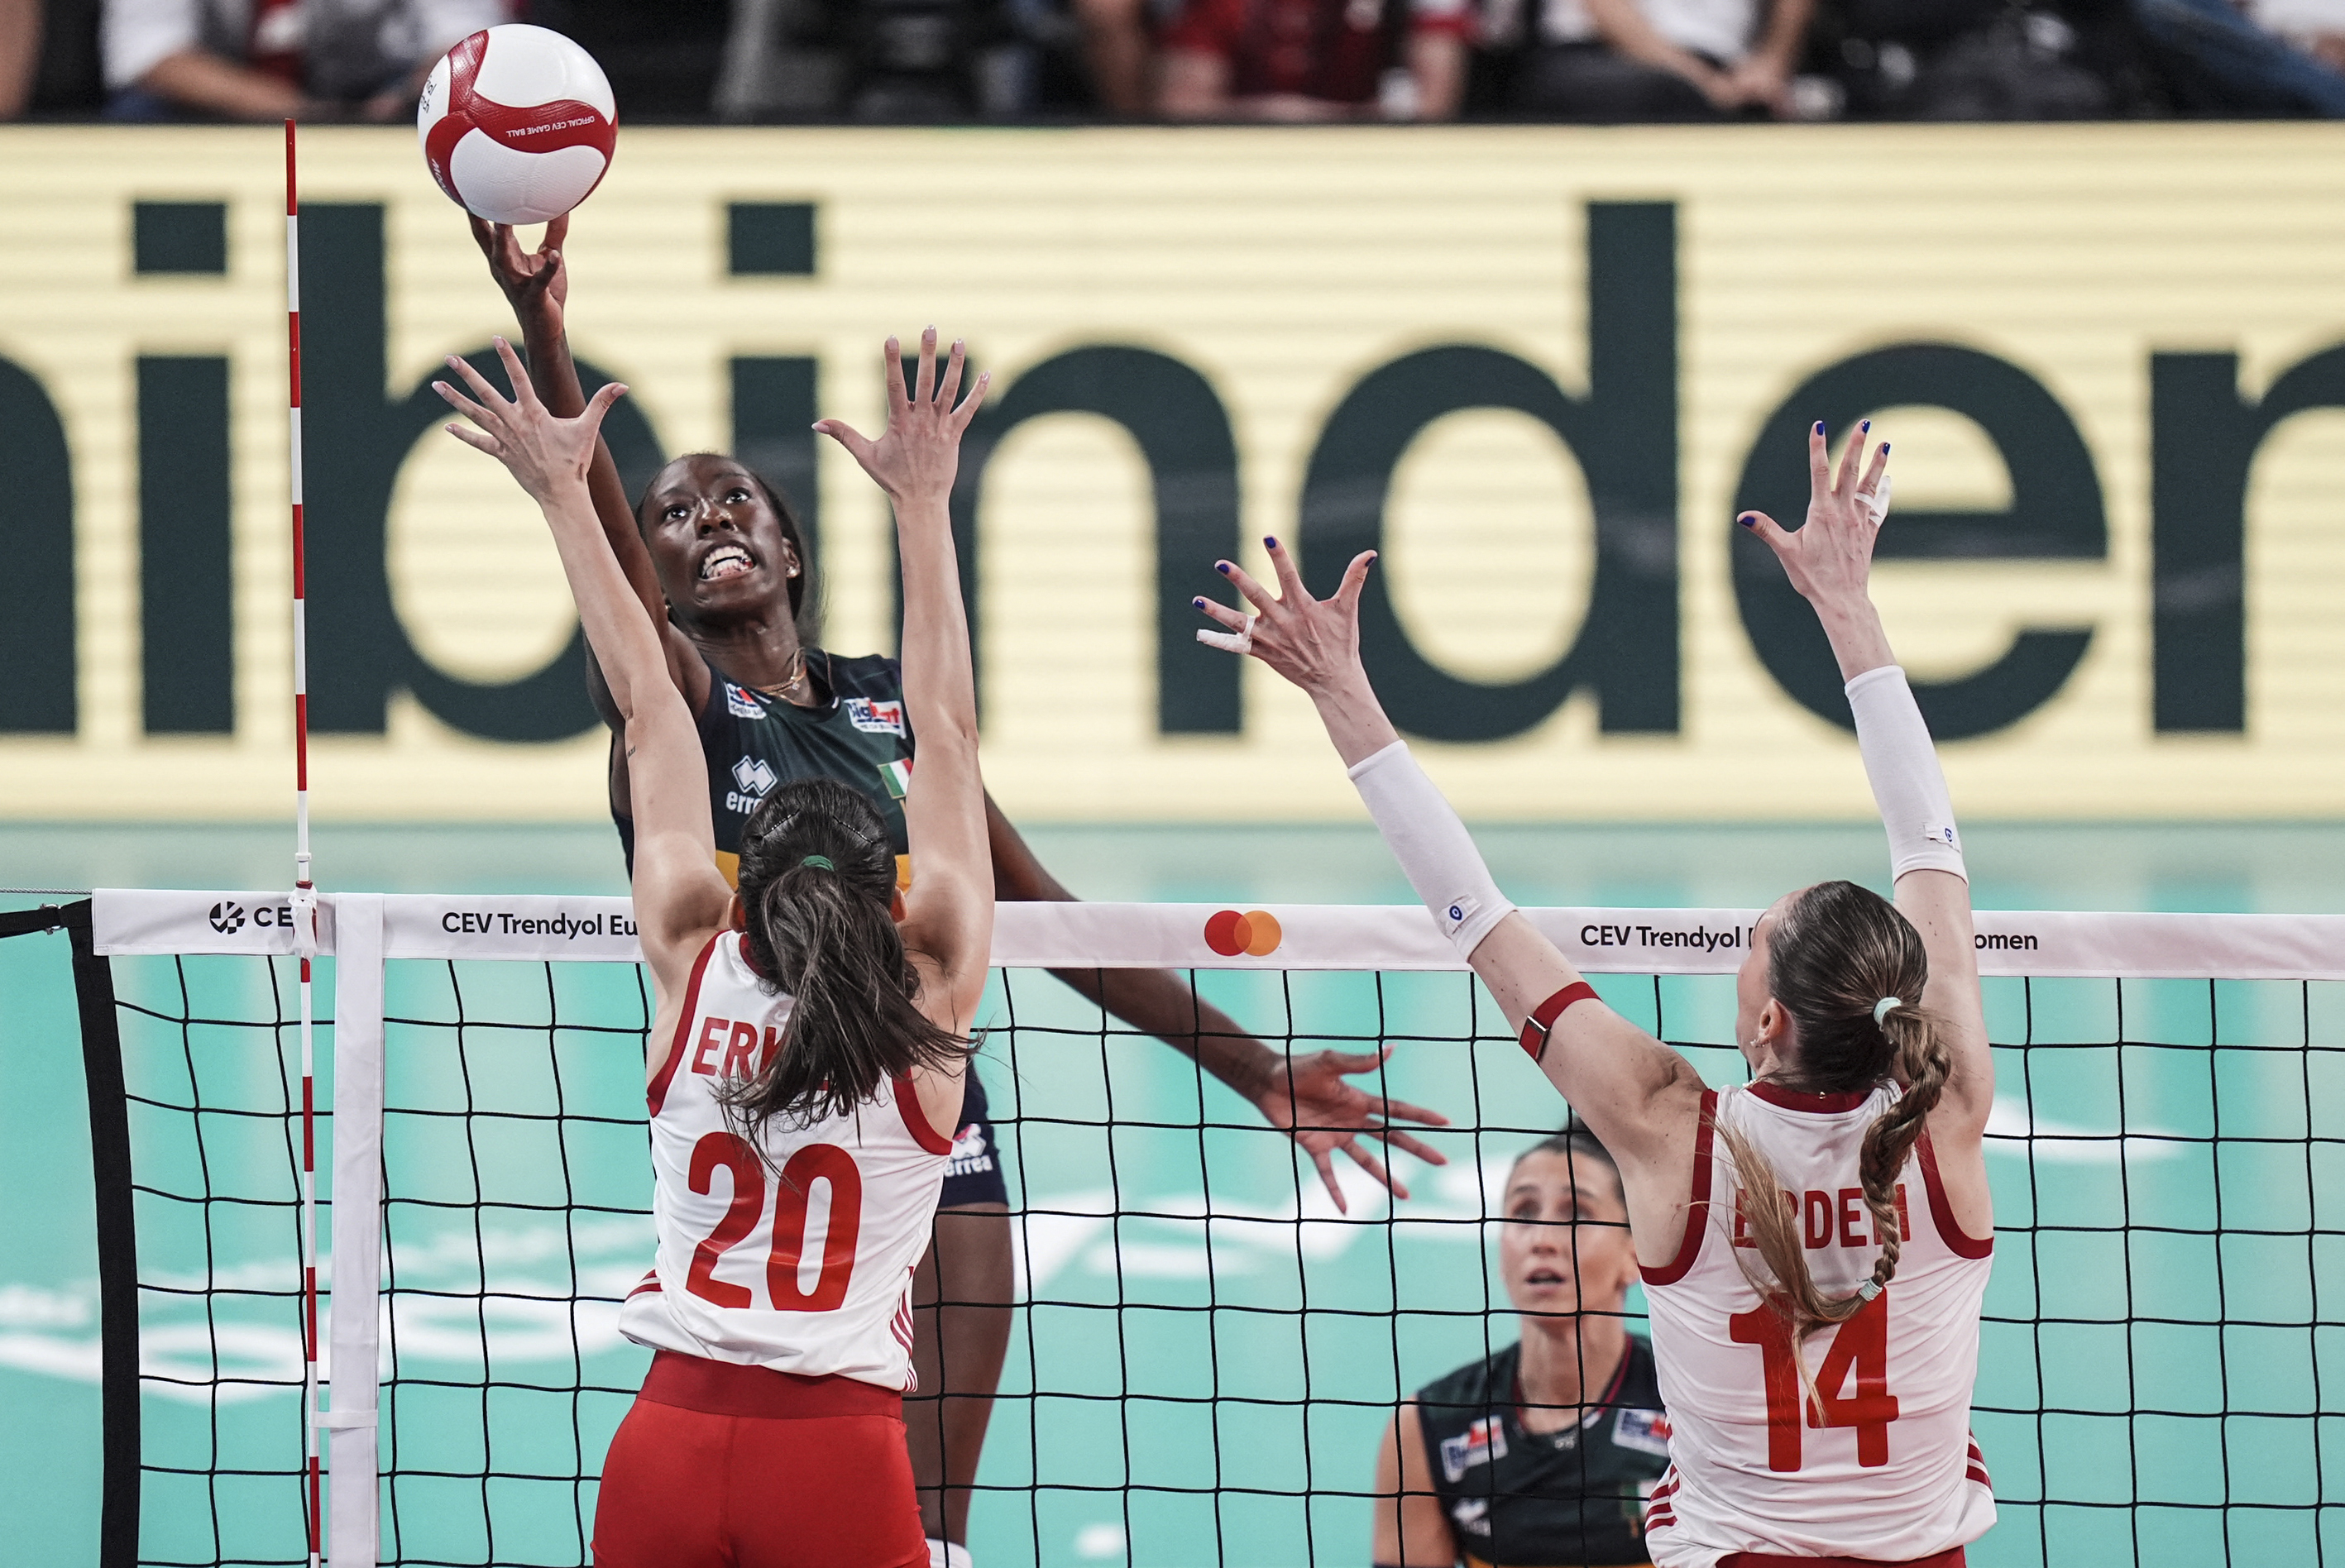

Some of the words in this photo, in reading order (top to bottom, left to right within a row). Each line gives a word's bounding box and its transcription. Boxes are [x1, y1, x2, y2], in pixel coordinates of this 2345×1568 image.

[527, 124, 551, 135] GAME
[552, 122, 567, 131] CEV
[567, 116, 596, 127] OFFICIAL
[505, 128, 526, 138] BALL
[253, 906, 294, 928] CE
[442, 911, 493, 934] CEV
[497, 912, 602, 940] Trendyol
[610, 914, 639, 936] Eu
[1581, 925, 1631, 946] CEV
[1635, 925, 1740, 954] Trendyol
[1974, 934, 2038, 950] omen
[685, 1131, 862, 1312] 20
[1729, 1285, 1899, 1472] 14
